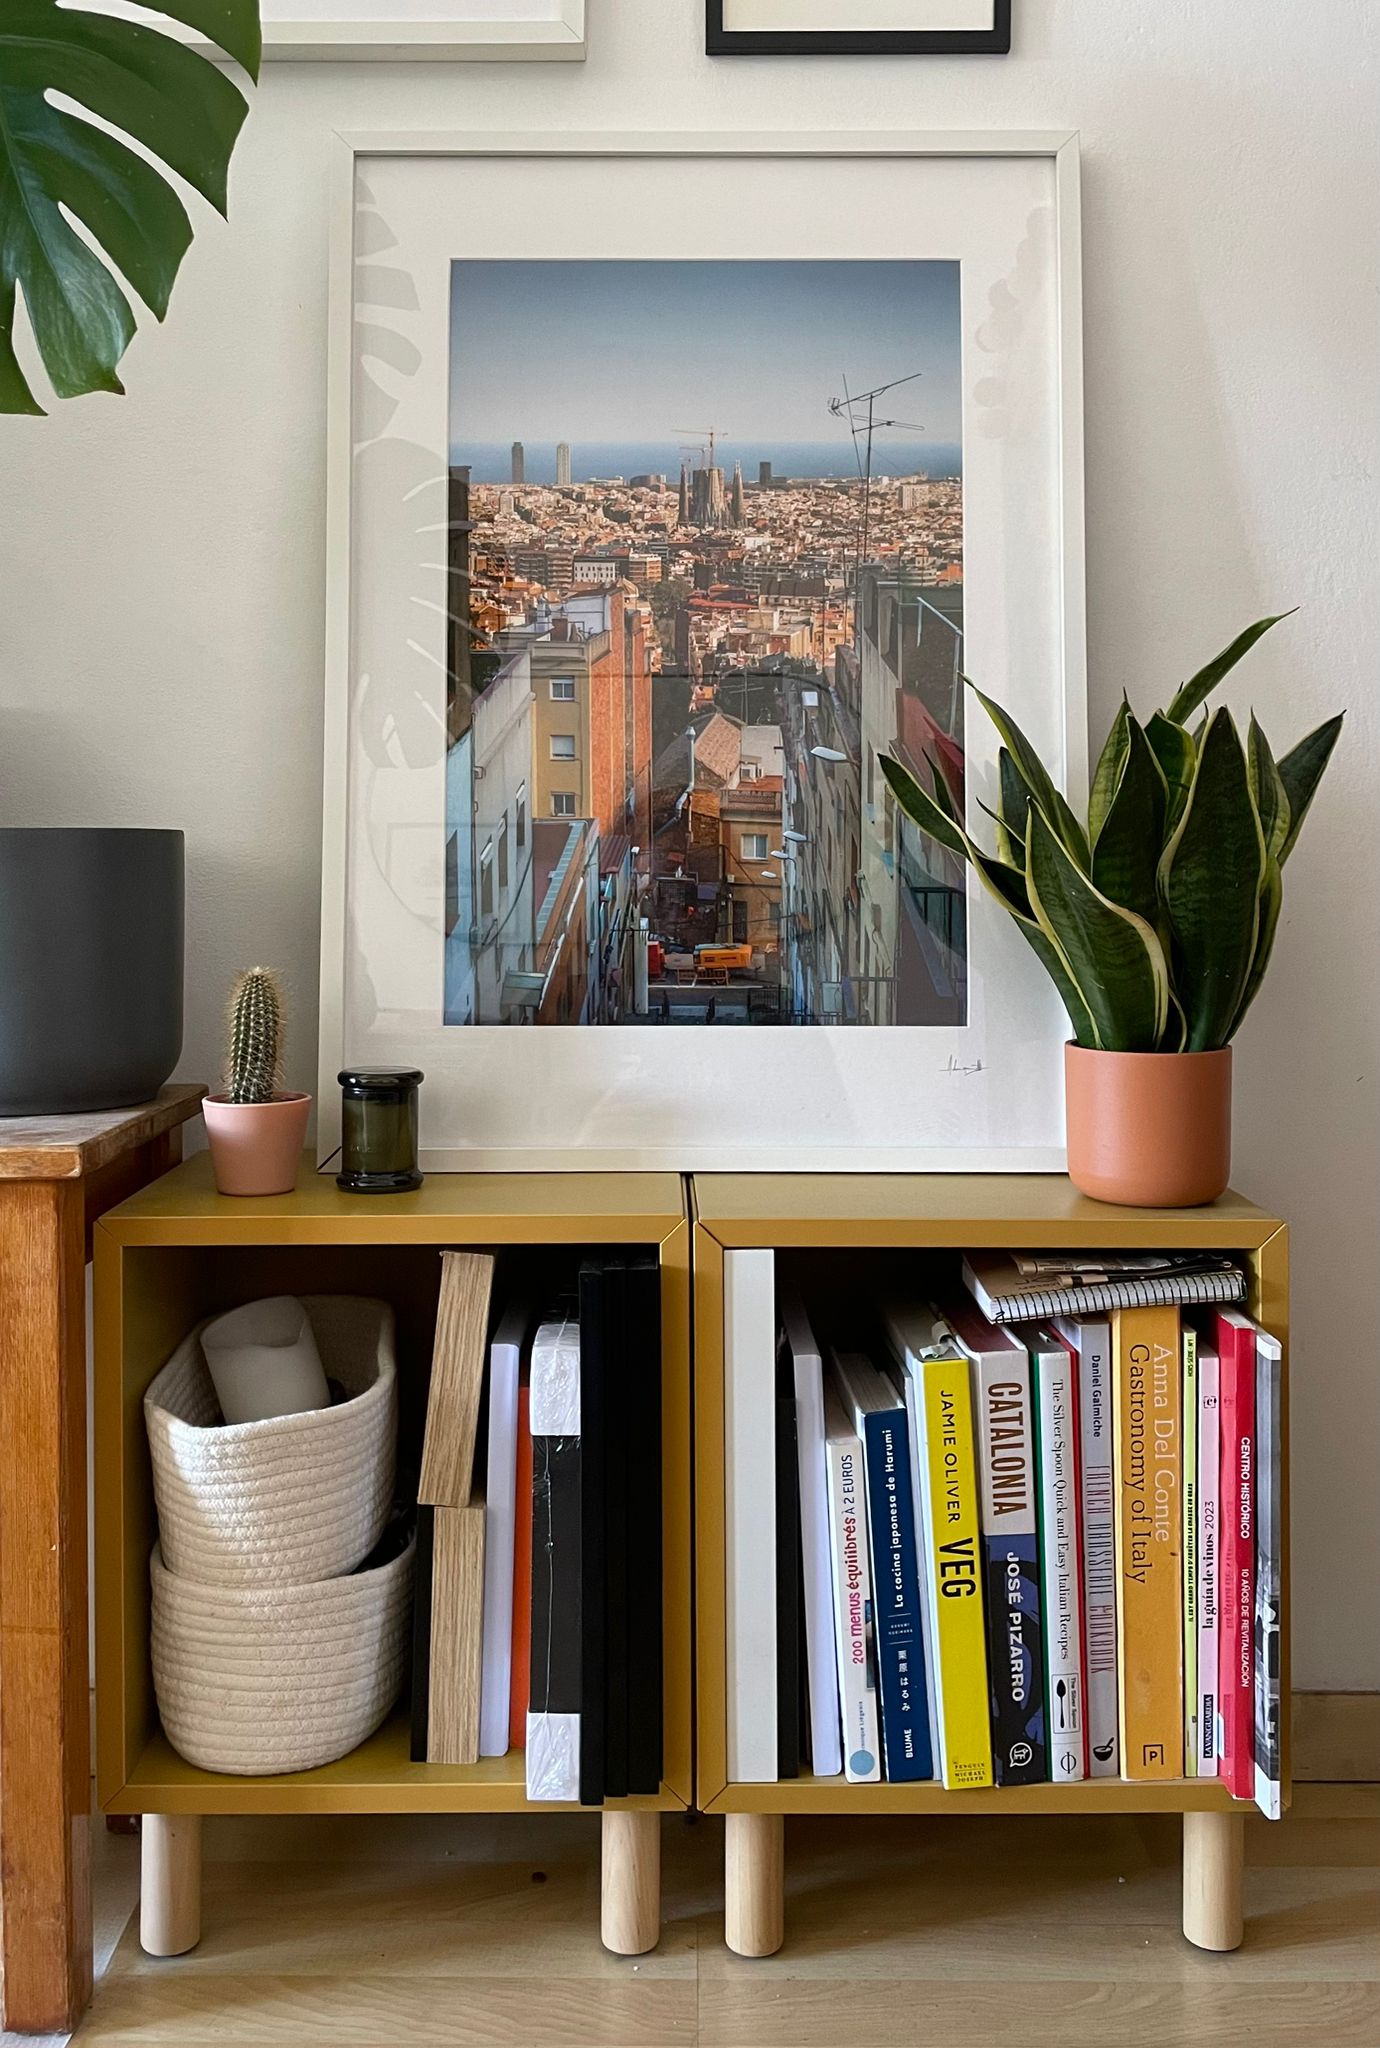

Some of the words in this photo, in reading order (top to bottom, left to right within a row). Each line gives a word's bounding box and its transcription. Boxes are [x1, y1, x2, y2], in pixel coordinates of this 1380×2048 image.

[1052, 1378, 1064, 1402] The
[1091, 1355, 1101, 1388] Daniel
[1154, 1344, 1173, 1408] Anna
[940, 1390, 957, 1446] JAMIE
[1053, 1405, 1066, 1438] Silver
[1092, 1390, 1103, 1438] Galmiche
[1124, 1343, 1151, 1491] Gastronomy
[881, 1429, 895, 1472] Harumi
[987, 1382, 1028, 1517] CATALONIA
[1051, 1440, 1066, 1476] Spoon
[1154, 1418, 1176, 1460] Del
[1240, 1436, 1251, 1480] CENTRO
[841, 1454, 855, 1494] EUROS
[885, 1476, 896, 1491] de
[944, 1452, 961, 1524] OLIVER
[1086, 1465, 1111, 1514] FRENCH
[843, 1496, 855, 1505] 2
[1052, 1479, 1068, 1514] Quick
[1131, 1499, 1153, 1523] of
[1154, 1469, 1175, 1542] Conte
[1204, 1500, 1215, 1530] 2023
[1240, 1482, 1252, 1539] HISTÓRICO
[889, 1495, 902, 1549] japonesa
[1056, 1519, 1069, 1539] and
[842, 1517, 862, 1590] équilibrés
[939, 1537, 977, 1599] VEG
[1055, 1543, 1070, 1570] Easy
[1087, 1523, 1113, 1595] BRASSERIE
[1124, 1530, 1153, 1584] Italy
[1202, 1532, 1214, 1567] vinos
[891, 1553, 902, 1590] cocina
[1006, 1551, 1025, 1605] JOSÉ
[1202, 1569, 1214, 1586] de
[1240, 1568, 1249, 1578] 10
[1240, 1580, 1251, 1603] AÑOS
[894, 1594, 904, 1608] La
[1058, 1574, 1071, 1610] Italian
[1201, 1587, 1217, 1615] guía
[1240, 1604, 1249, 1619] DE
[848, 1591, 863, 1637] menus
[1202, 1617, 1214, 1629] la
[852, 1640, 864, 1665] 200
[1058, 1614, 1072, 1660] Recipes
[1088, 1605, 1114, 1674] COOKBOOK
[1240, 1620, 1251, 1688] REVITALIZACIÓN
[1008, 1612, 1025, 1703] PIZARRO
[903, 1728, 914, 1758] BLUME
